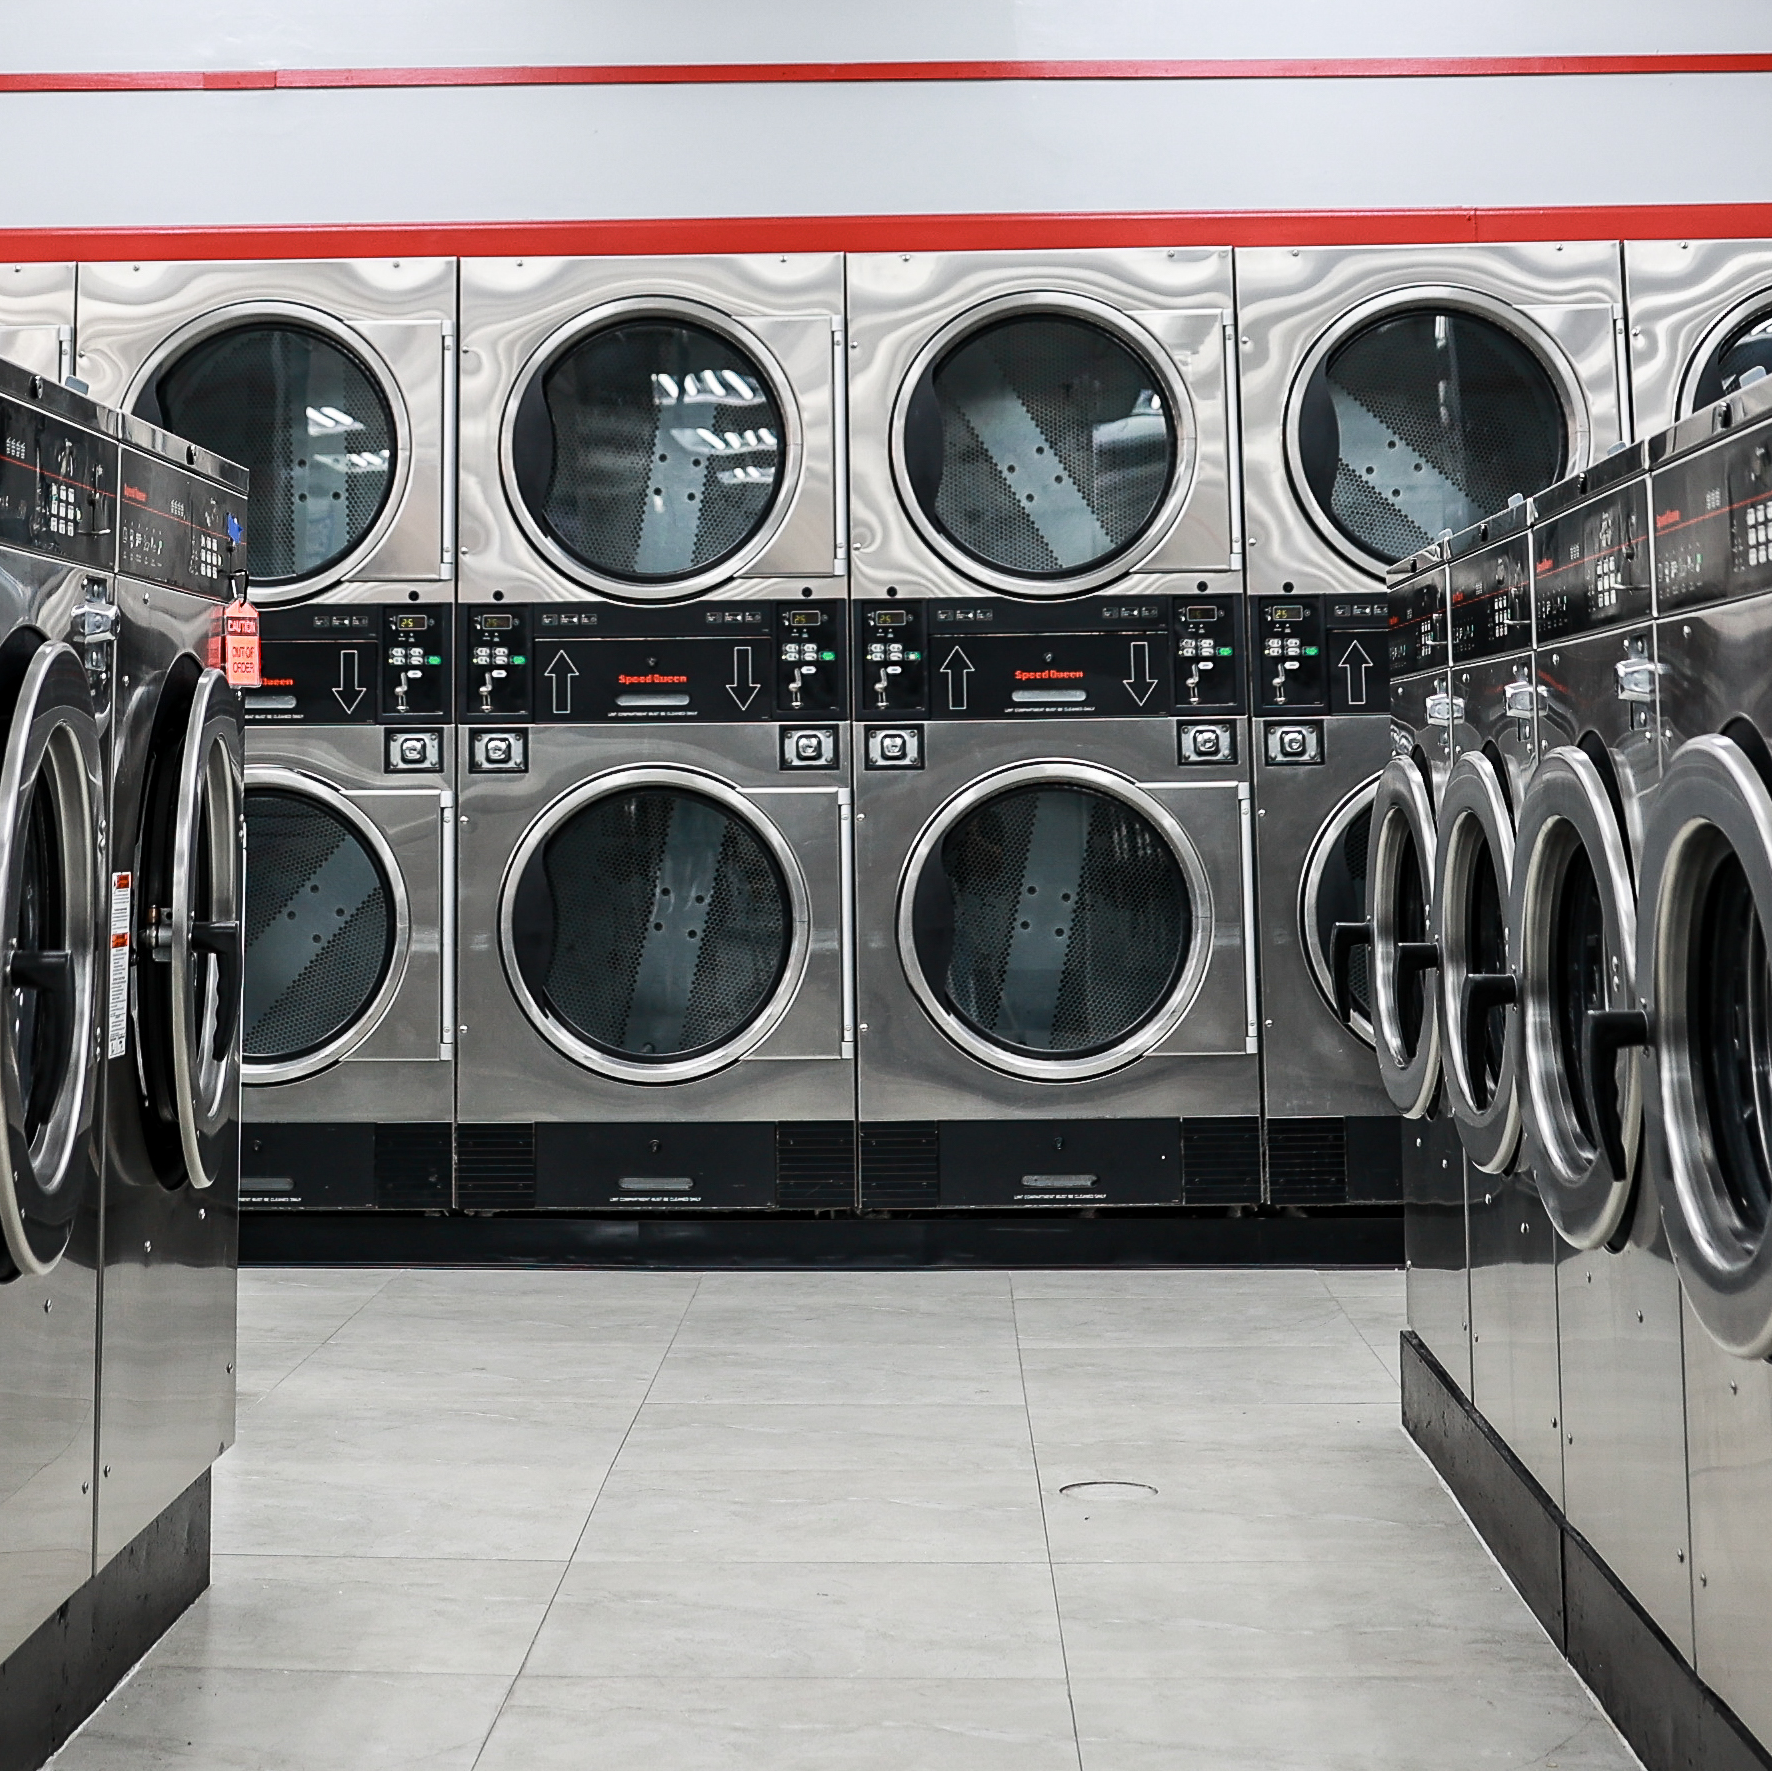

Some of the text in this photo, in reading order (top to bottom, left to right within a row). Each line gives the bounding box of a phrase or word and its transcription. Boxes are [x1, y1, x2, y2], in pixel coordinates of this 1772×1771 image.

[227, 619, 256, 633] CAUTION
[232, 646, 255, 658] OUT OF
[232, 661, 255, 674] ORDER
[618, 673, 687, 685] Speed Queen
[1014, 669, 1084, 681] Speed Queen
